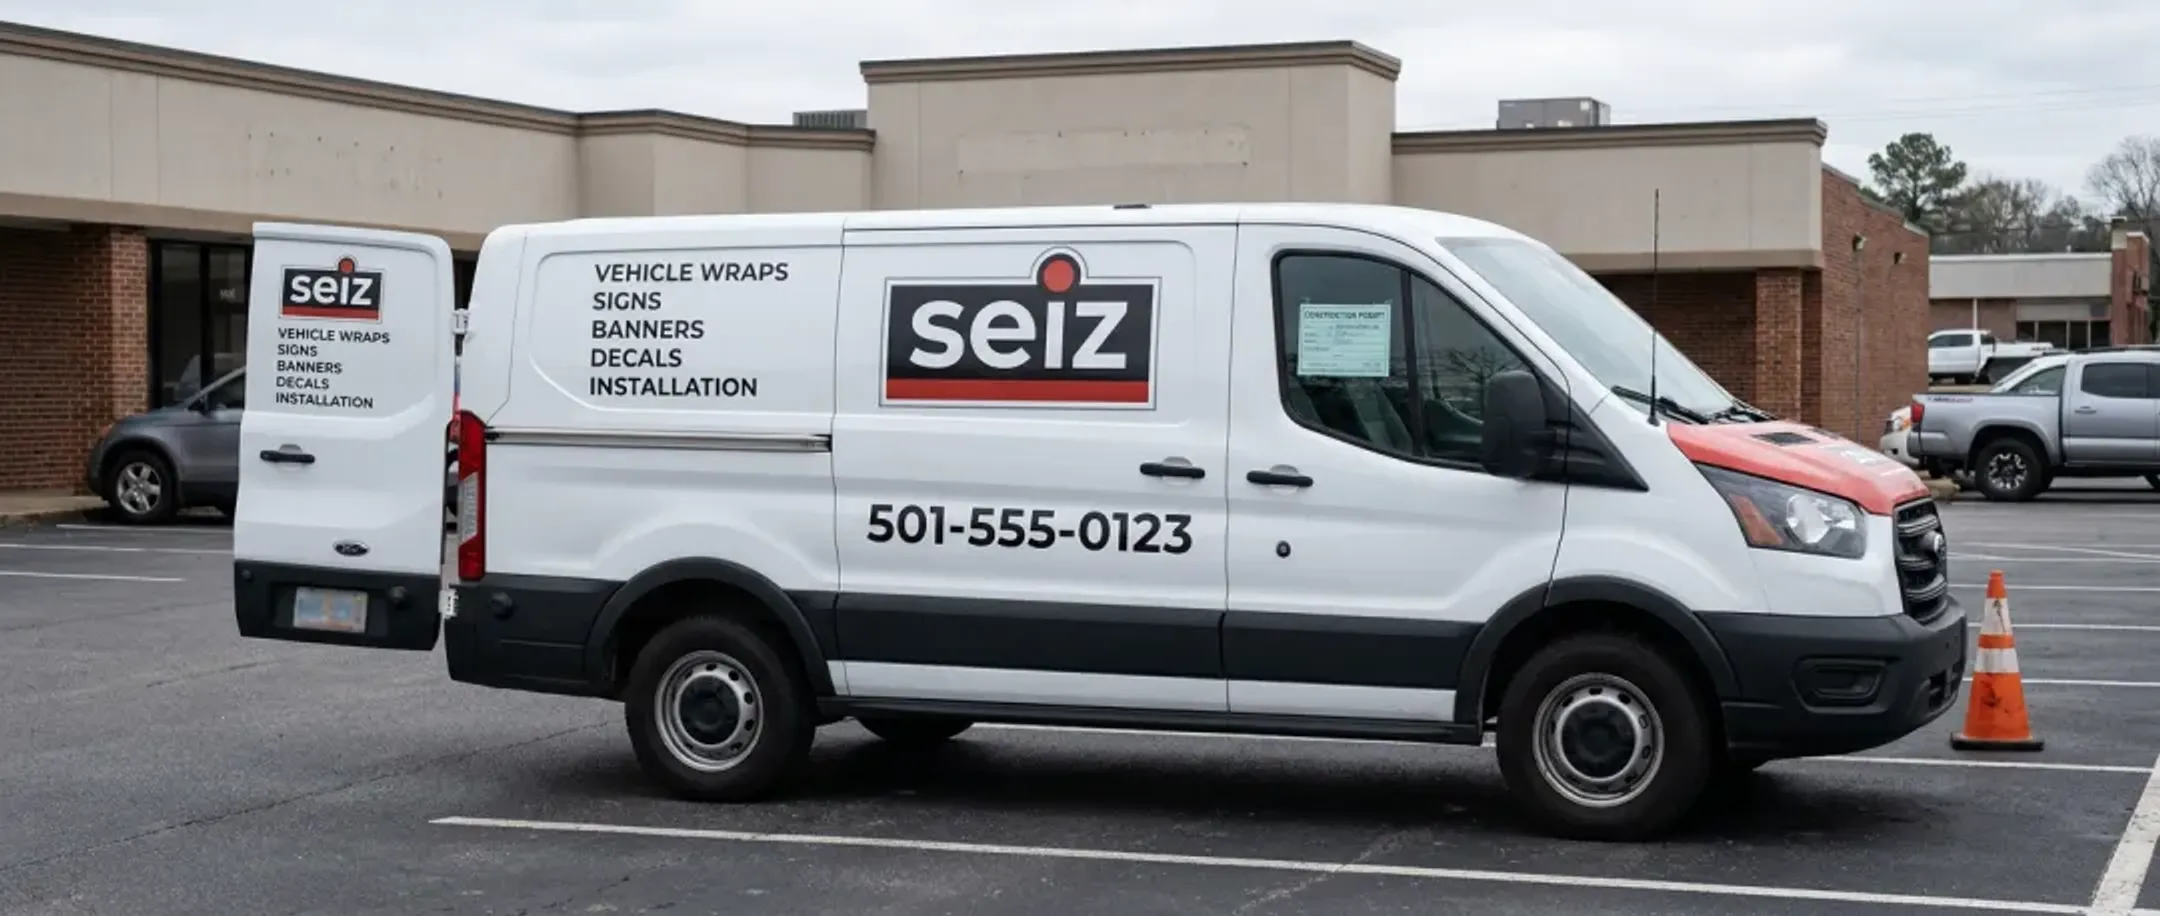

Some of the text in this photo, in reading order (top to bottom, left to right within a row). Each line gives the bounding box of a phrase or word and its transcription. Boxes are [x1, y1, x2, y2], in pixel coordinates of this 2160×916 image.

[291, 258, 373, 305] seiz
[595, 262, 789, 283] VEHICLE WRAPS
[592, 291, 662, 311] SIGNS
[910, 258, 1128, 369] seiz
[277, 327, 391, 345] VEHICLE WRAPS
[592, 319, 704, 339] BANNERS
[277, 343, 318, 358] SIGNS
[590, 348, 682, 368] DECALS
[276, 359, 343, 375] BANNERS
[275, 375, 330, 391] DECALS
[590, 376, 757, 397] INSTALLATION
[275, 391, 374, 410] INSTALLATION
[866, 503, 1193, 554] 501-555-0123
